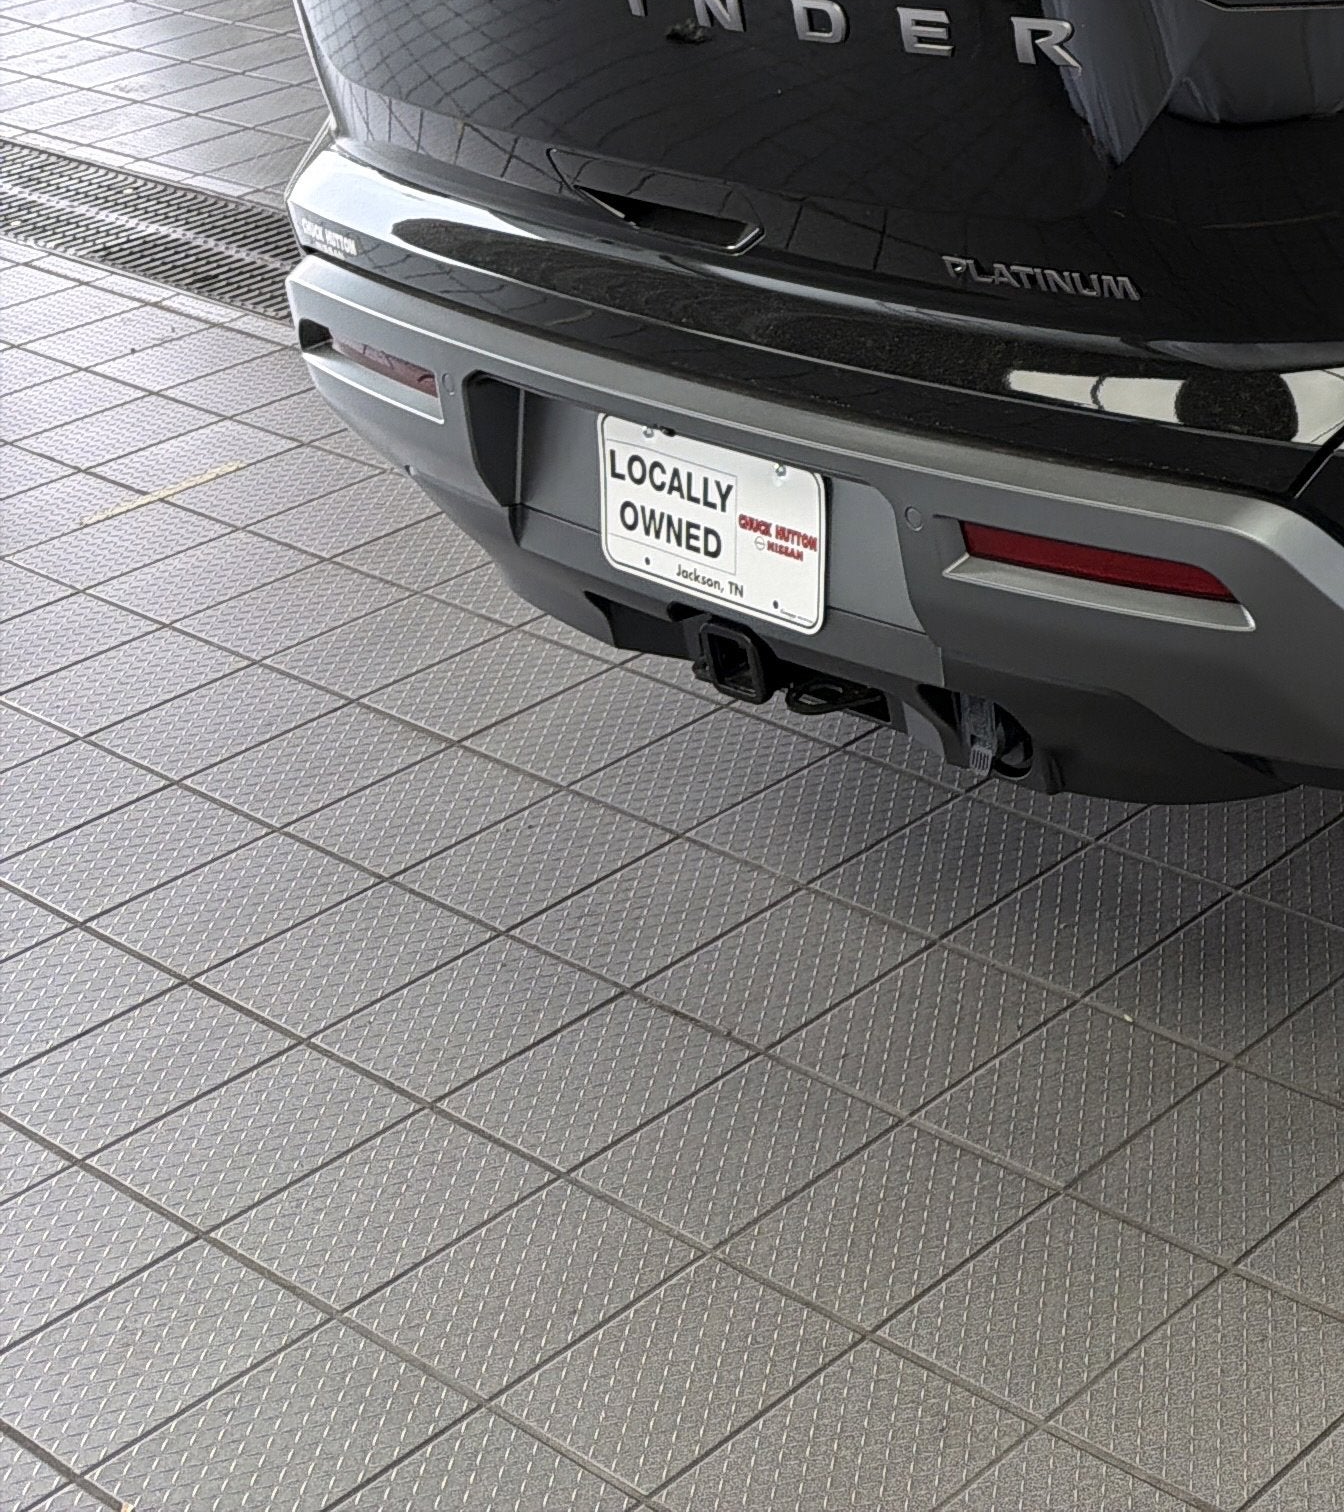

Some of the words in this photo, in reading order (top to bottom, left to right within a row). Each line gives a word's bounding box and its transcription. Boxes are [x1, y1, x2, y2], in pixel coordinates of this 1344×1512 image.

[941, 254, 1141, 301] PLATINUM
[609, 448, 733, 513] LOCALLY
[619, 500, 722, 559] OWNED
[738, 513, 773, 538] CHUCK
[775, 524, 817, 552] HUTTON
[766, 540, 804, 562] NISSAN
[676, 563, 725, 593] Jackson,
[728, 580, 744, 598] TN
